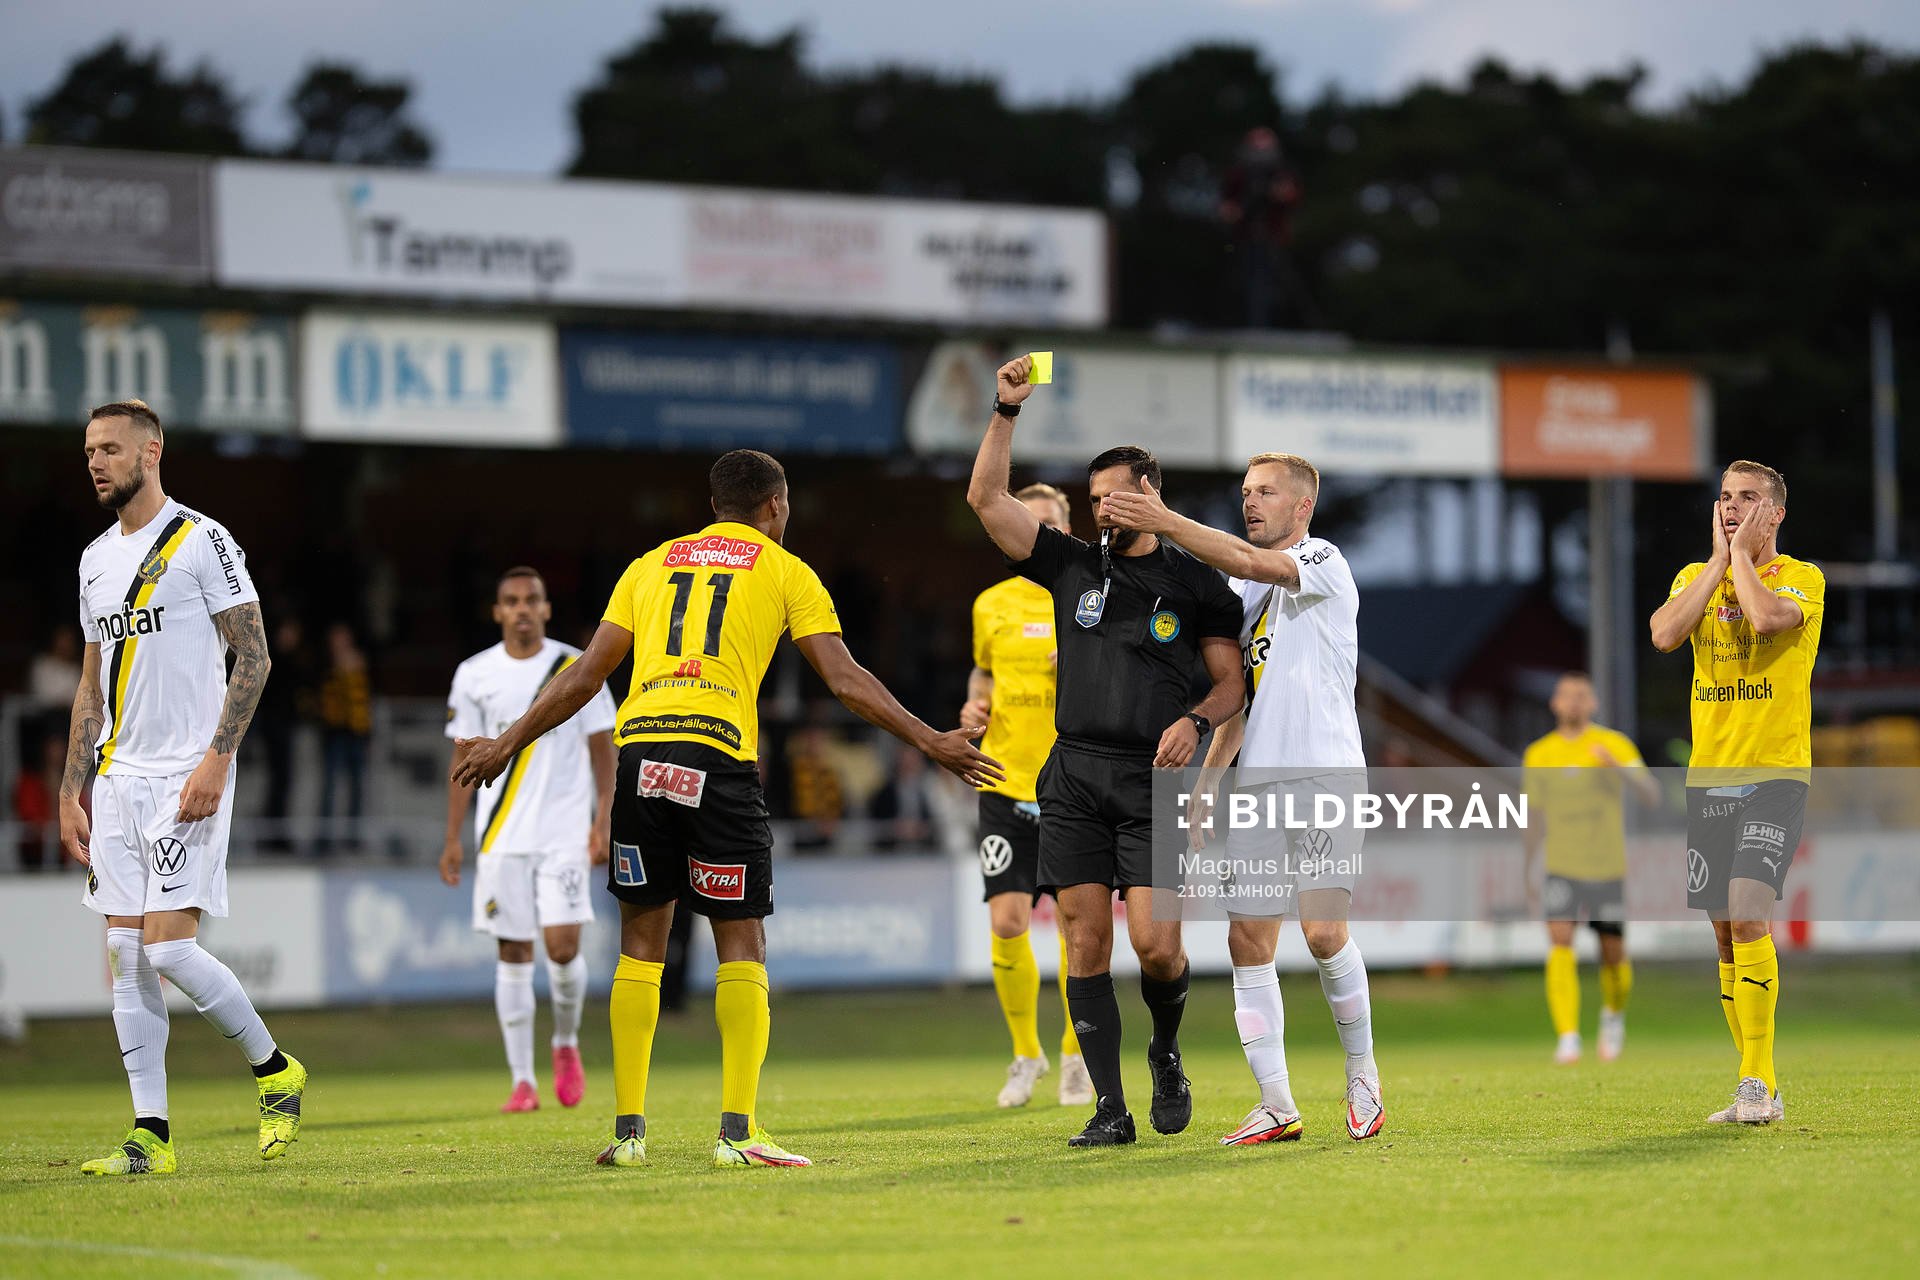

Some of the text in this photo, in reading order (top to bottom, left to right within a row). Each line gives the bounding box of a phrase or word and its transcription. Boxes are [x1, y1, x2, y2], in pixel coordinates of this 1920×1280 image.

[671, 536, 759, 557] marching
[666, 553, 688, 565] on
[97, 602, 165, 642] notar
[665, 571, 735, 657] 11
[1695, 676, 1773, 702] Sweden Rock
[1742, 824, 1786, 843] LB-HUS
[692, 867, 739, 890] EXTRA
